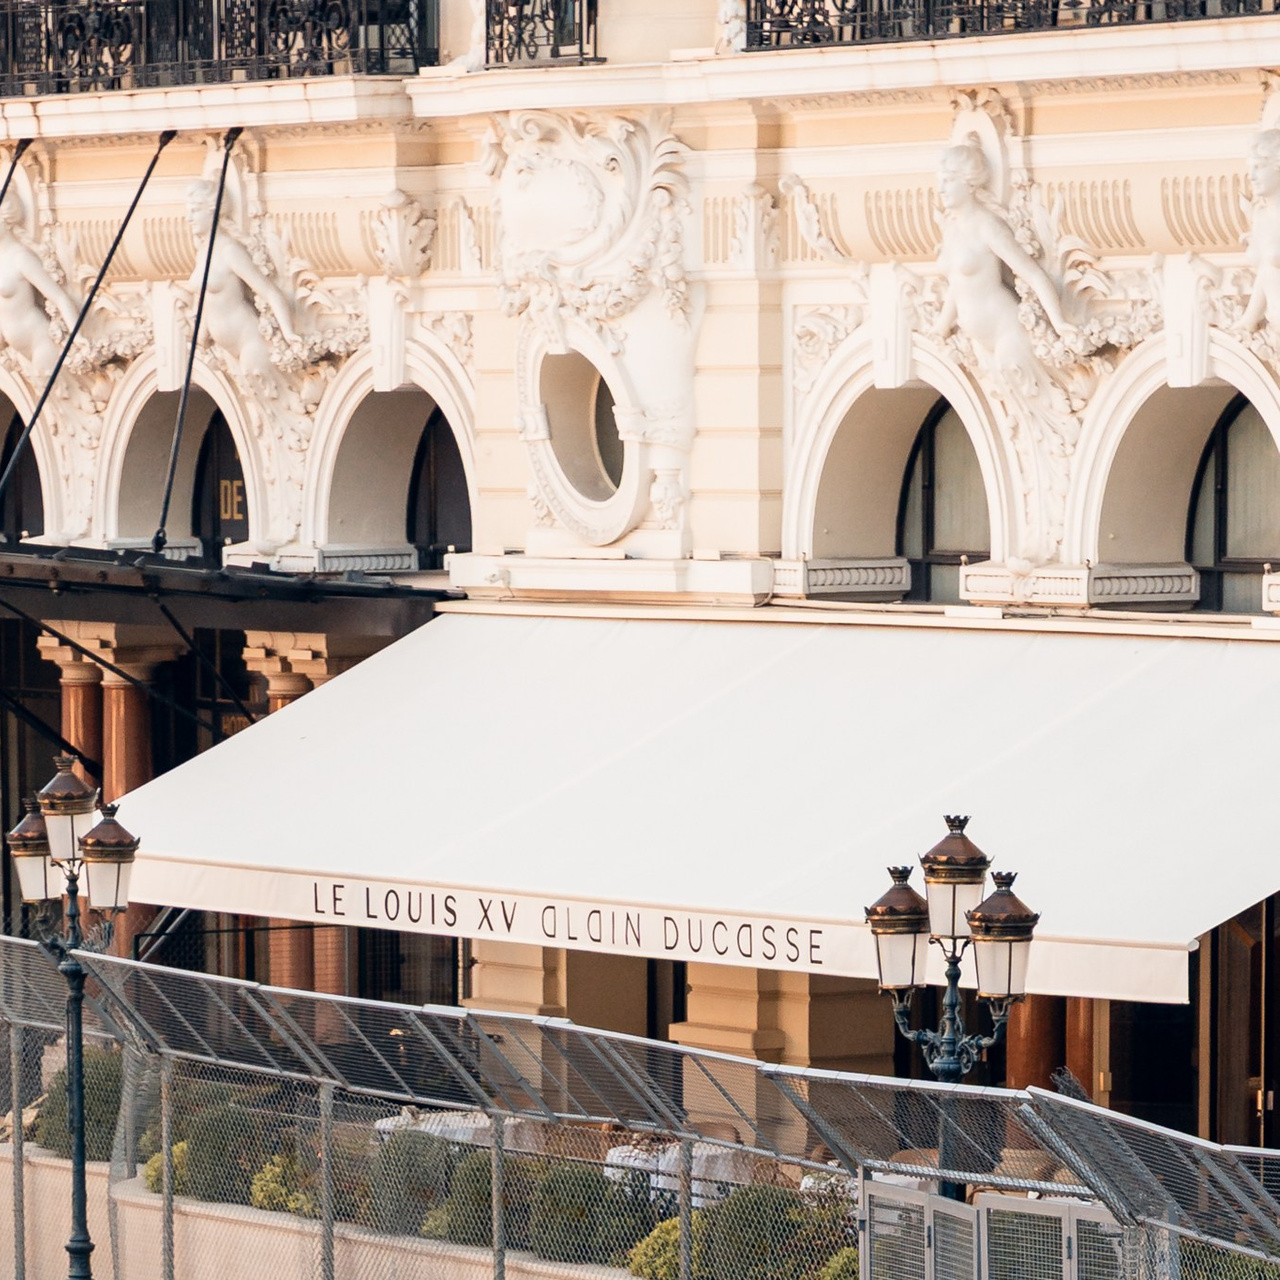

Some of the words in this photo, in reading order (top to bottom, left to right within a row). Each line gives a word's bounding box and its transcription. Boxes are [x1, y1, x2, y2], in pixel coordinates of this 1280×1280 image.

[220, 480, 244, 520] DE
[313, 882, 346, 916] LE
[365, 887, 458, 929] LOUIS
[477, 899, 518, 935] XV
